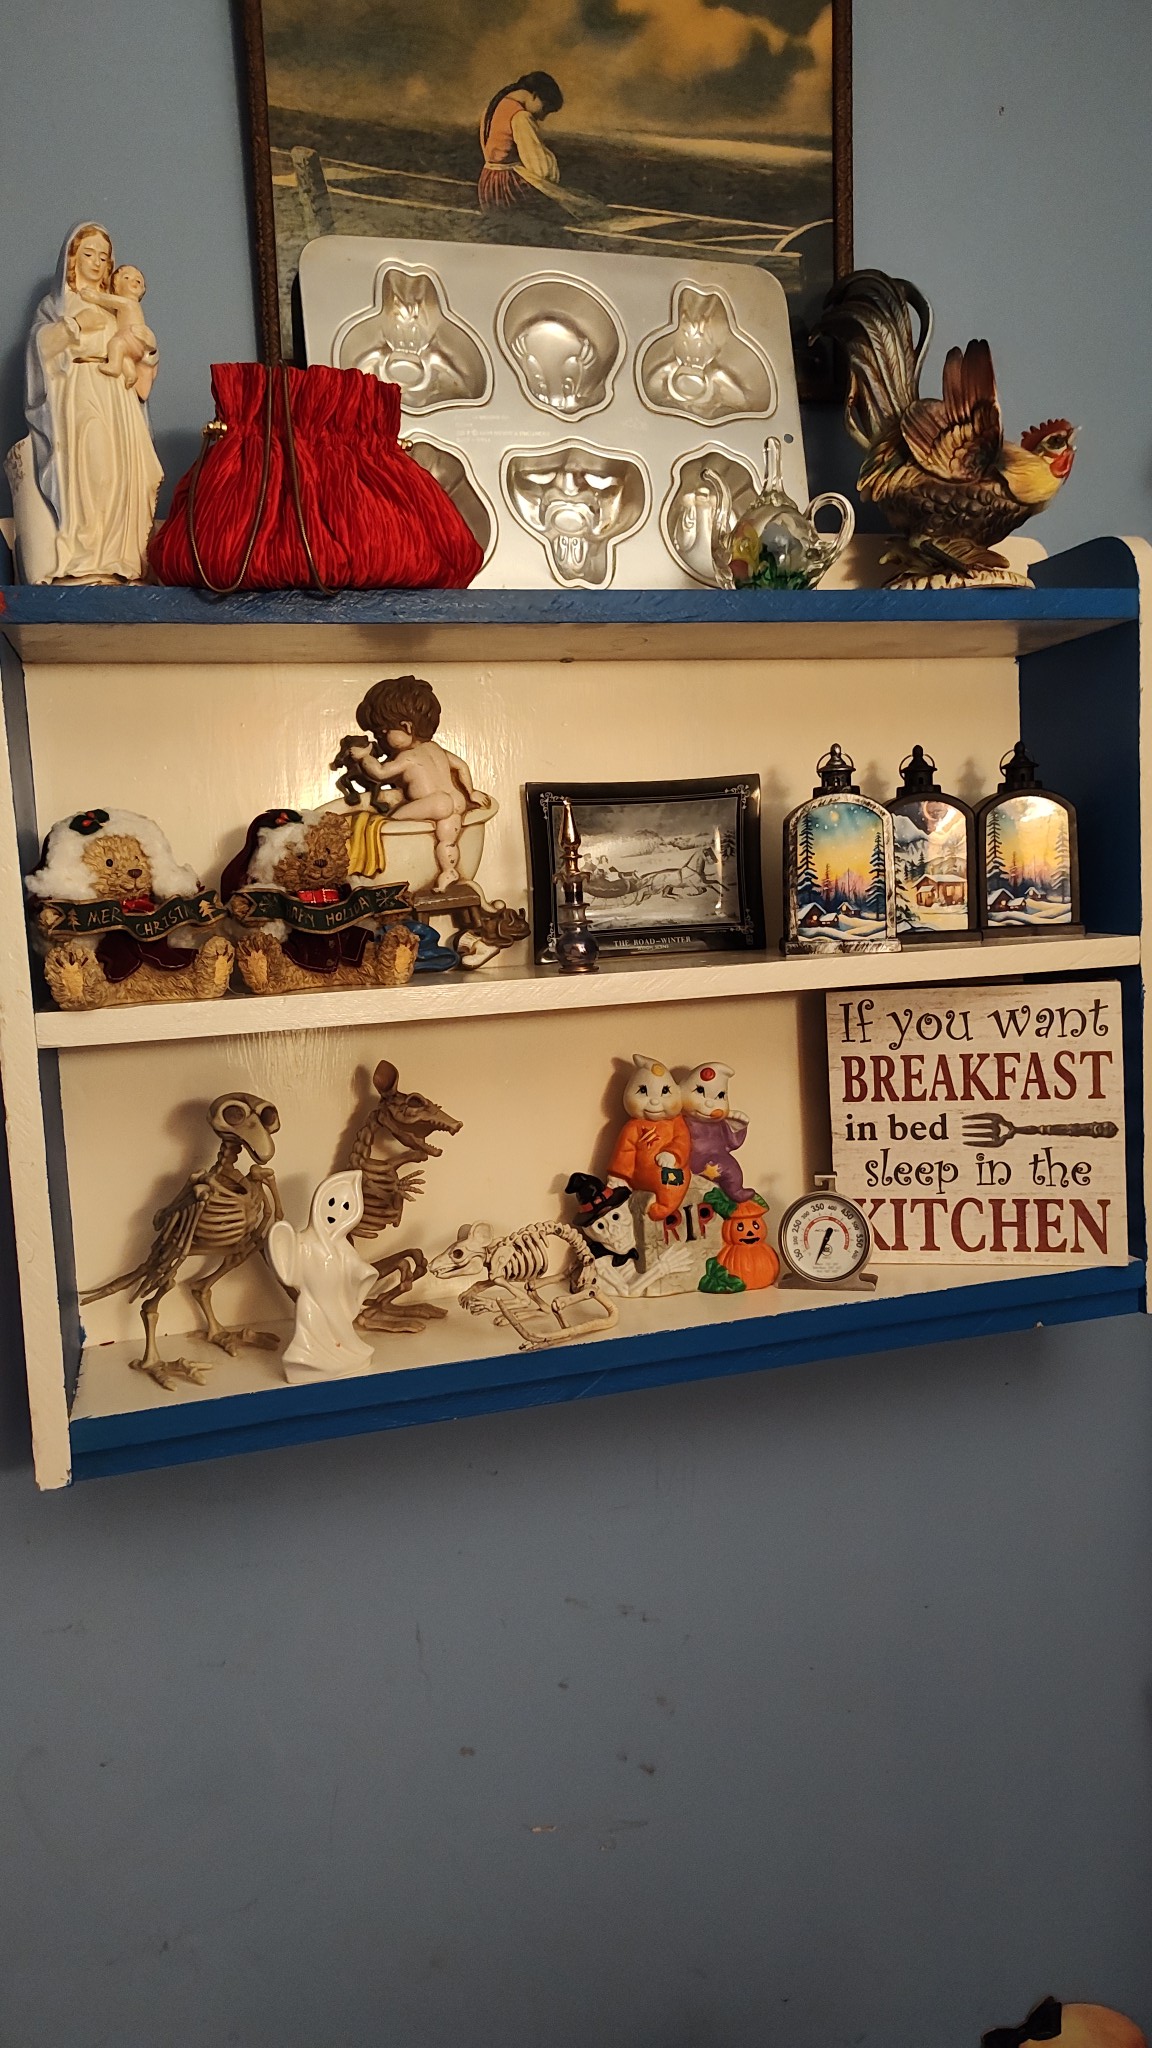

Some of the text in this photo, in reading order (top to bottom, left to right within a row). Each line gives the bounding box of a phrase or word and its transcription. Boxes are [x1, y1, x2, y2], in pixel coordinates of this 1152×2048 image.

[87, 904, 193, 937] MER CHRIST
[613, 940, 631, 948] THE
[838, 998, 1110, 1051] If you want
[840, 1050, 1113, 1103] BREAKFAST
[845, 1112, 950, 1141] in bed
[864, 1146, 1093, 1195] sleep in the
[810, 1202, 825, 1213] 350
[840, 1208, 854, 1220] 450
[663, 1202, 715, 1246] RIP
[791, 1219, 802, 1233] 250
